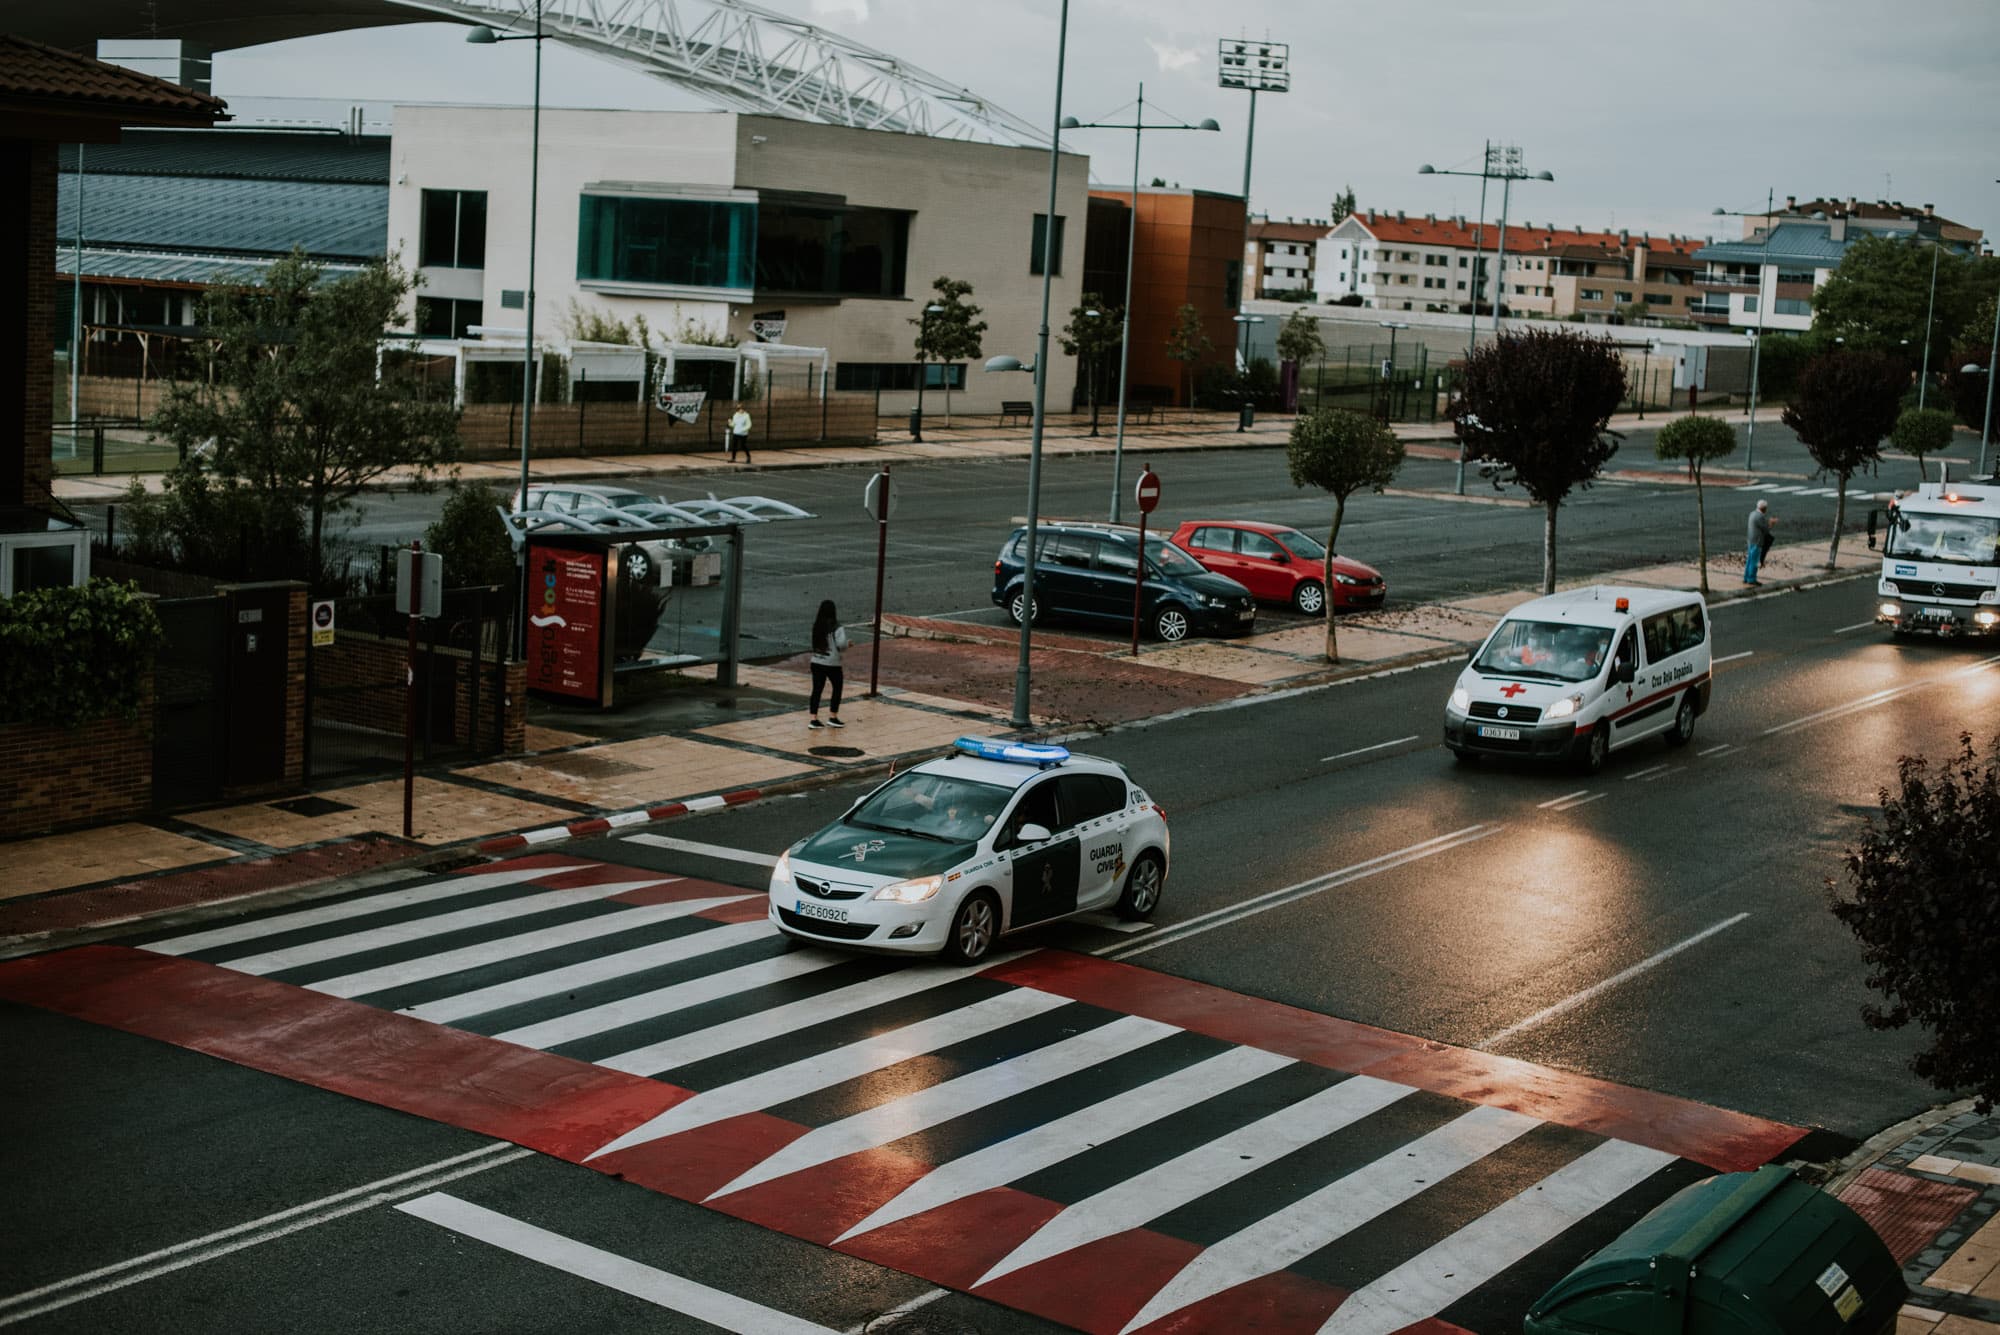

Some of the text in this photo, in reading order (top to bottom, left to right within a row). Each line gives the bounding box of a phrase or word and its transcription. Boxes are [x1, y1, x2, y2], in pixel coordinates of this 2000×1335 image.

[675, 403, 698, 417] sport
[1651, 675, 1662, 689] Cruz
[1090, 842, 1122, 861] GUARDIA
[800, 903, 848, 922] PGC6092C
